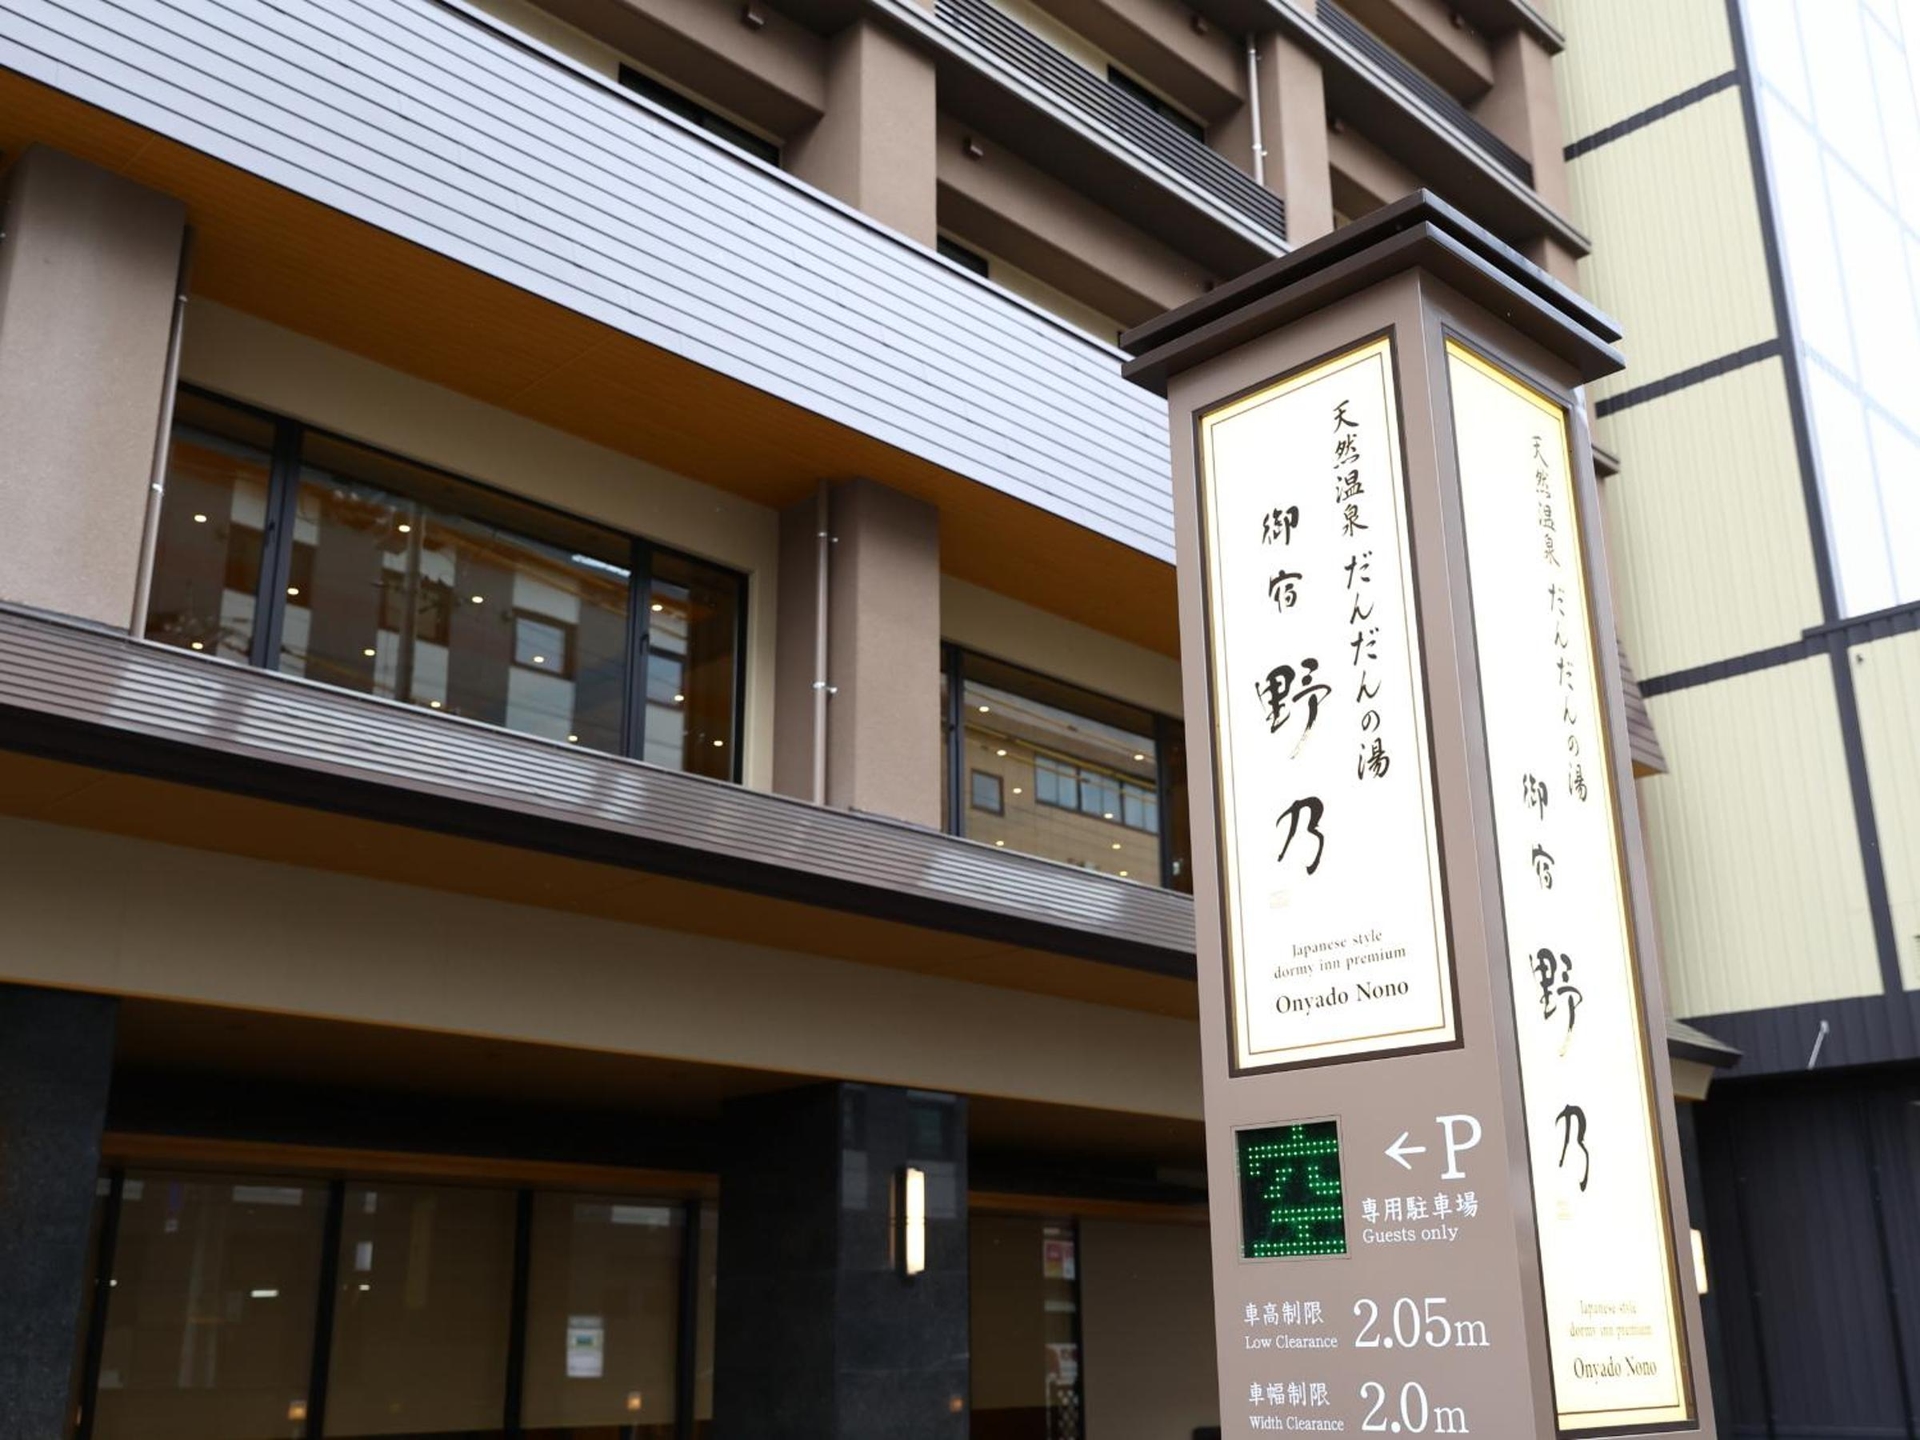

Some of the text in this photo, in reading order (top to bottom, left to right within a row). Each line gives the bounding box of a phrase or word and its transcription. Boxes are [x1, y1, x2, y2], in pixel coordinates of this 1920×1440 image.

[1333, 399, 1391, 781] 天然温泉 だんだんの湯
[1292, 928, 1383, 958] Japanese style
[1273, 946, 1407, 980] dormy inn premium
[1275, 980, 1409, 1016] Onyado Nono
[1435, 1114, 1482, 1180] P
[1248, 1123, 1344, 1256] 空
[1361, 1191, 1479, 1224] 専用駐車場
[1362, 1225, 1459, 1244] Guests only
[1244, 1301, 1325, 1326] 車高制限
[1353, 1297, 1490, 1348] 2.05m
[1245, 1334, 1338, 1350] Low Clearance
[1249, 1382, 1330, 1406] 車幅制限
[1360, 1381, 1469, 1433] 2.0m
[1249, 1415, 1344, 1431] Width Clearance
